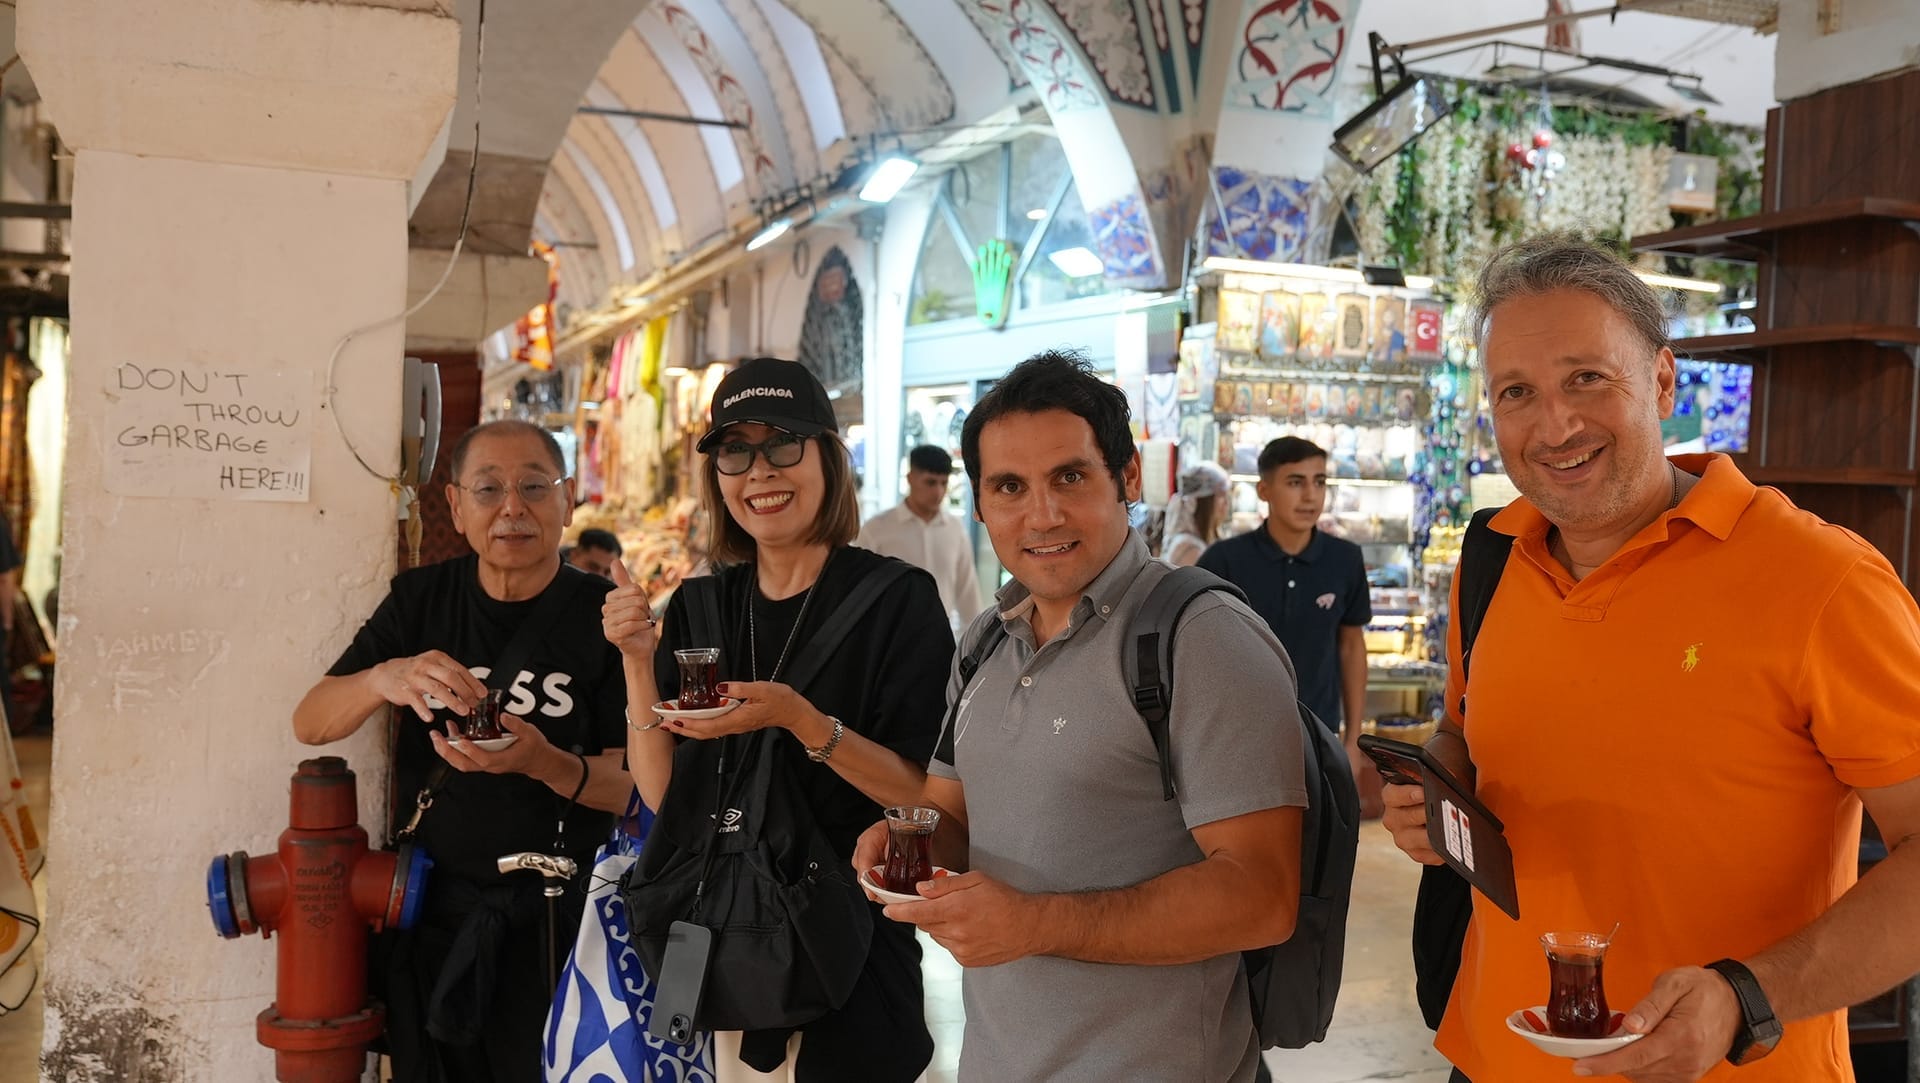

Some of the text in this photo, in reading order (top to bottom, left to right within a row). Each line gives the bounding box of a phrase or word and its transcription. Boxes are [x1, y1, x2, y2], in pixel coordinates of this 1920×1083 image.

[118, 362, 248, 397] DON'T
[723, 387, 794, 409] BALENCIAGA
[184, 403, 300, 427] THROW
[117, 424, 268, 454] GARBAGE
[220, 465, 304, 495] HERE!!!
[422, 666, 574, 718] SS
